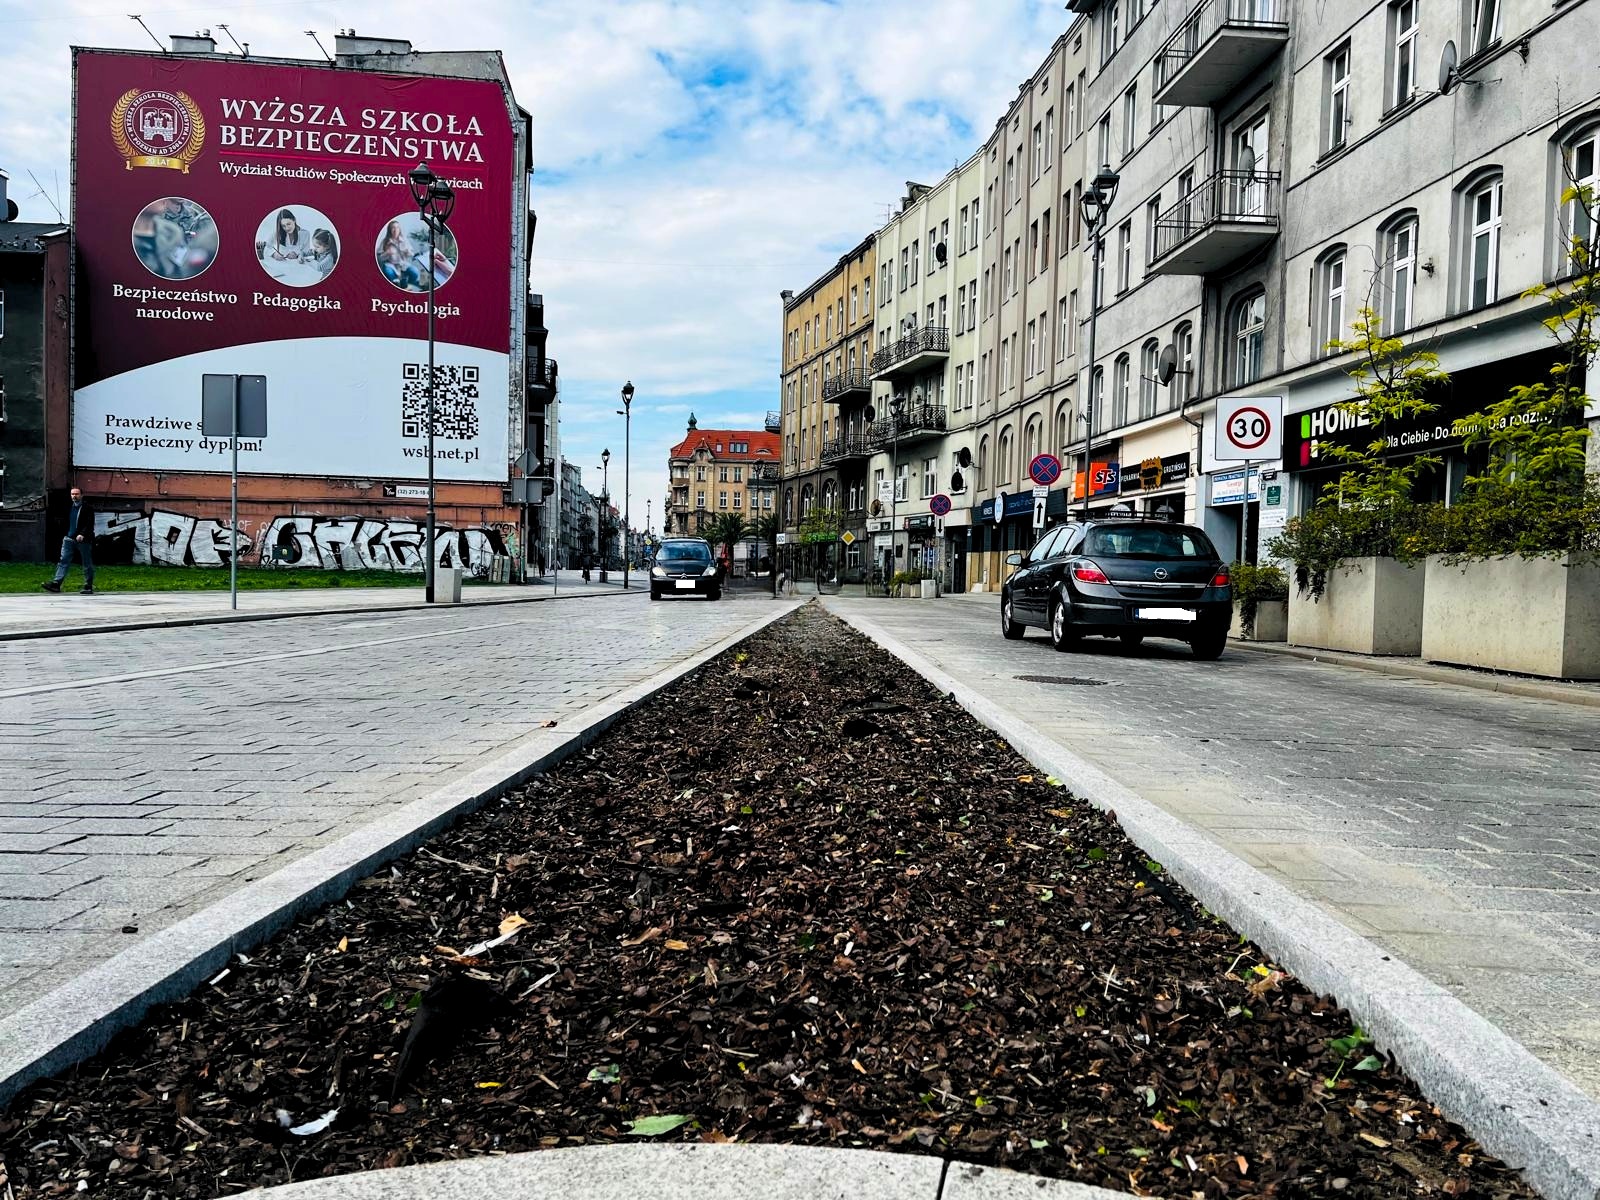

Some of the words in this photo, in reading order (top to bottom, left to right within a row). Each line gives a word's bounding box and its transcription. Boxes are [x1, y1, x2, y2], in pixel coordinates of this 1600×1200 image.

[219, 96, 348, 126] WYŻSZA
[361, 108, 484, 136] SZKOŁA
[219, 125, 485, 163] BEZPIECZEŃSTWA
[219, 161, 272, 178] Wydział
[274, 165, 327, 180] Studiów
[329, 168, 407, 188] Społecznych
[112, 284, 238, 304] Bezpieczeństwo
[252, 292, 342, 313] Pedagogika
[136, 306, 214, 321] narodowe
[105, 414, 193, 431] Prawdziwe
[1233, 418, 1265, 438] 30
[1311, 399, 1371, 437] HOME
[105, 433, 194, 453] Bezpieczny
[199, 437, 263, 454] dyplom!
[1400, 429, 1430, 446] Ciebie
[1435, 426, 1449, 440] Do
[1095, 469, 1116, 484] STS
